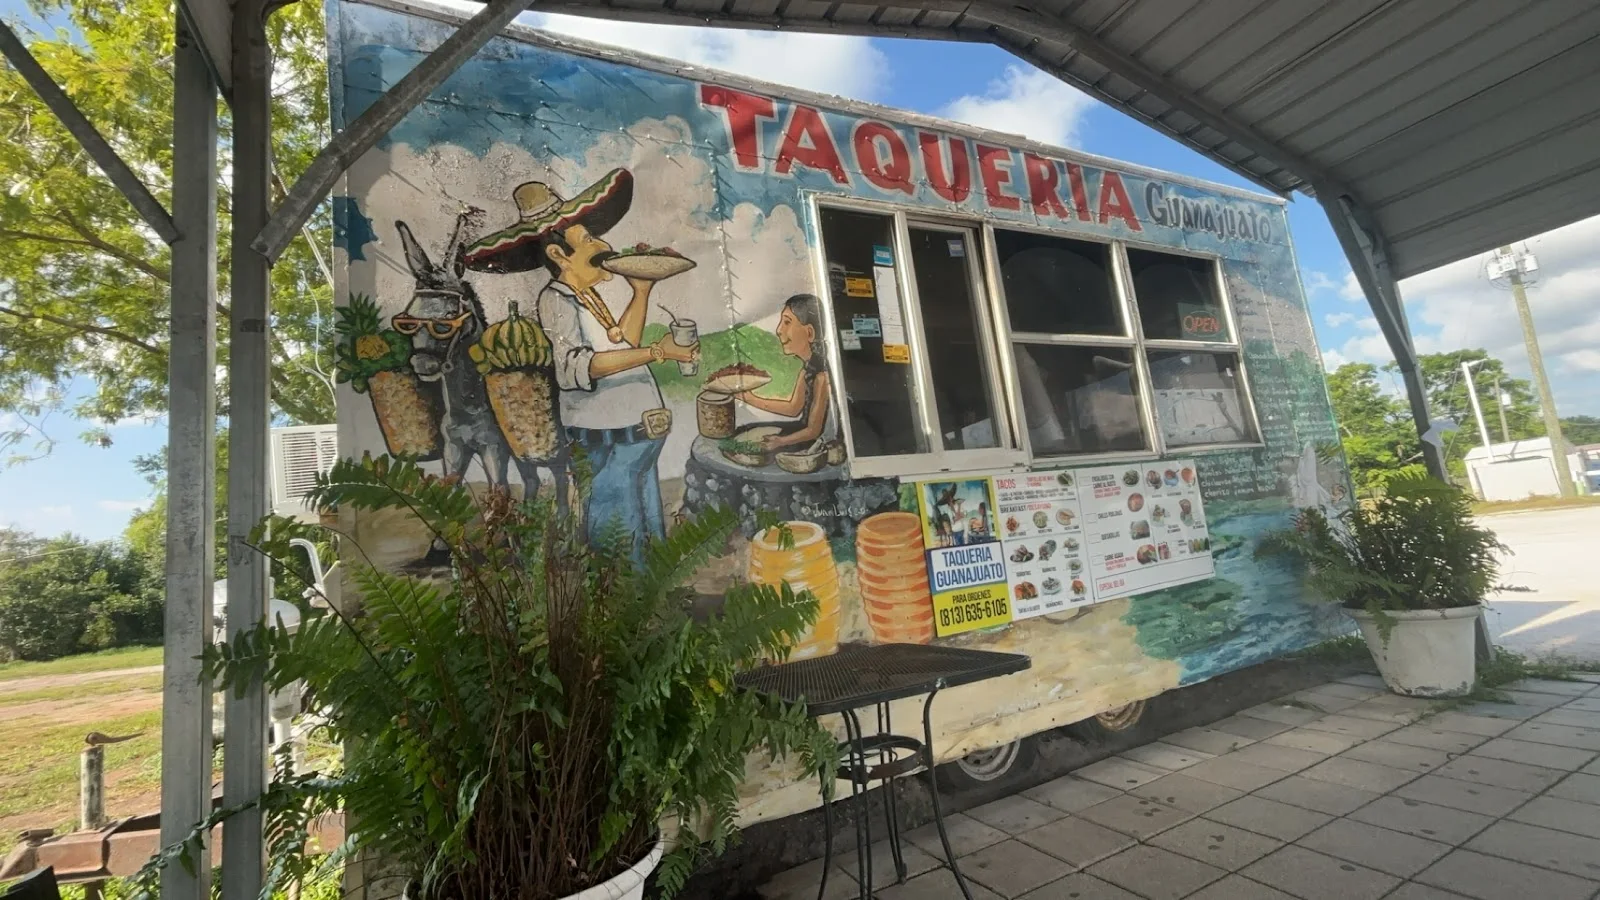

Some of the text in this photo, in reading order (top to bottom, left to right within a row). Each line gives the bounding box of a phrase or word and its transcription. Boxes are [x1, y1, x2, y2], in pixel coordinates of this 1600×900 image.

[699, 83, 1271, 243] TAQUERIA Guanajuato
[1183, 315, 1220, 332] OPEN
[996, 478, 1016, 490] TACOS
[942, 546, 993, 568] TAQUERIA
[936, 562, 1004, 588] GUANAJUATO
[952, 589, 992, 604] PARA ORDENES
[940, 605, 965, 627] (813)
[965, 598, 1007, 622] 635-6105
